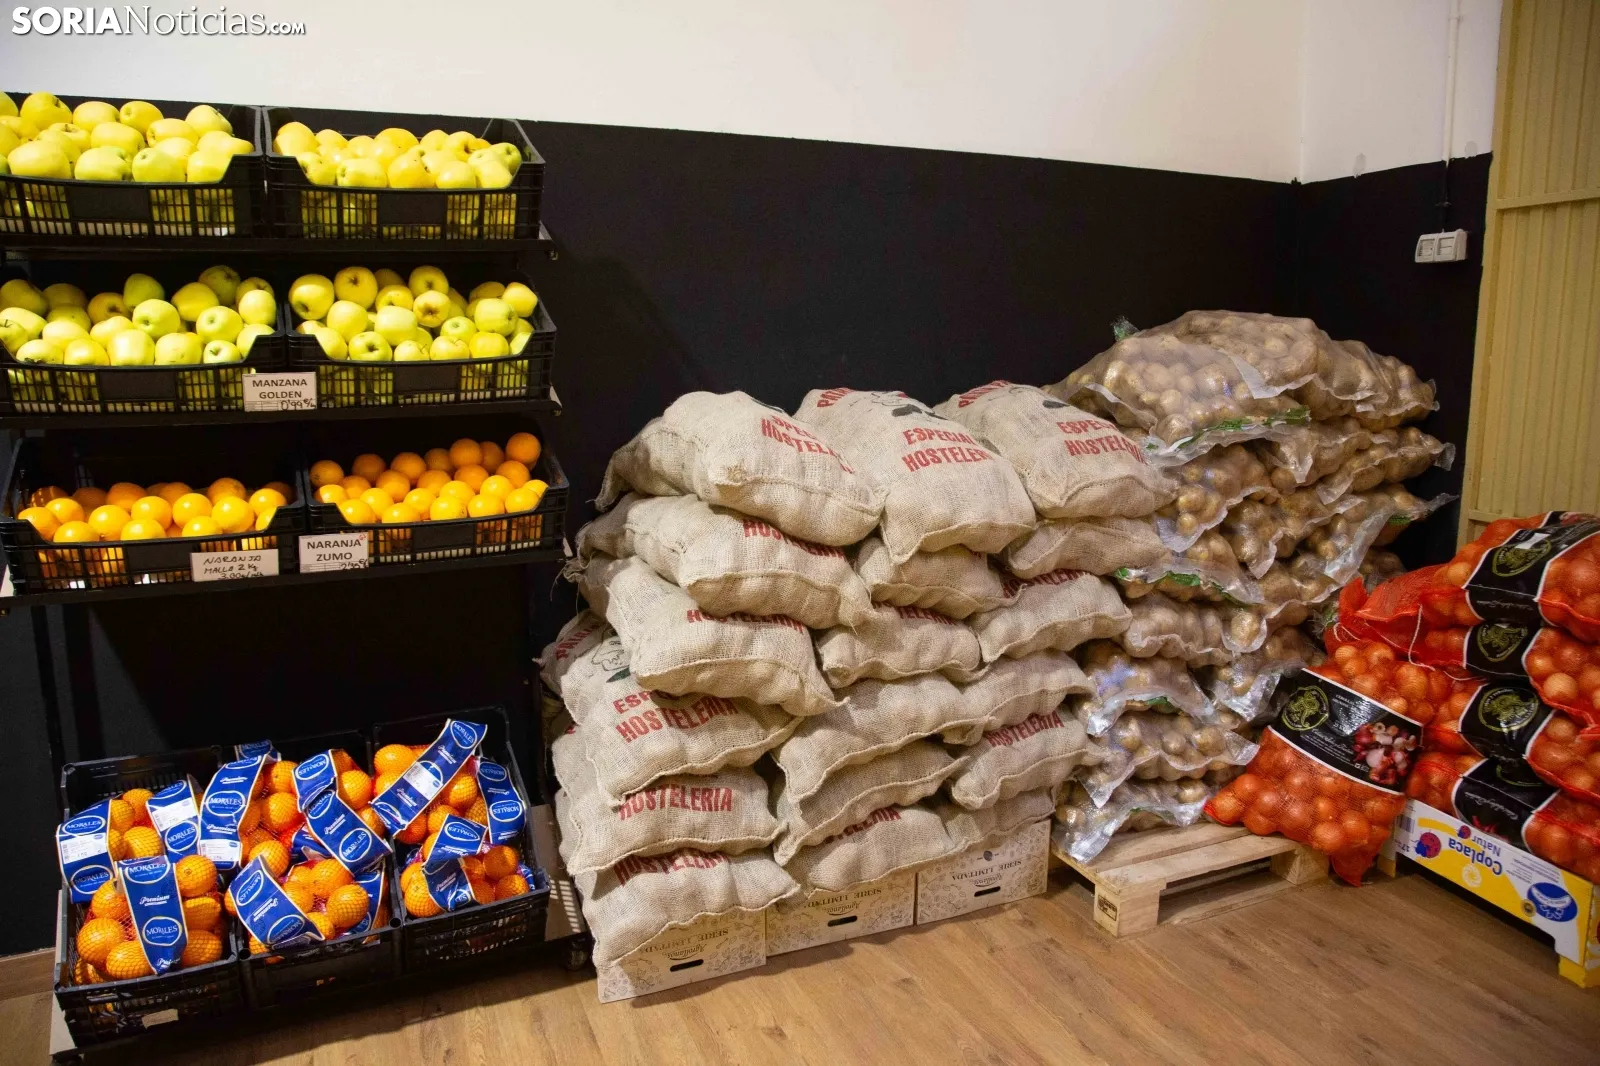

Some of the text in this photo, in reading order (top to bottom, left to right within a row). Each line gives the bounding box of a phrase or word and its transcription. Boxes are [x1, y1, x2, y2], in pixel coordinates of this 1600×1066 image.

[252, 379, 307, 387] MANZANA
[259, 391, 302, 399] GOLDEN
[307, 540, 361, 549] NARANJA
[316, 552, 352, 562] ZUMO
[616, 696, 739, 743] HOSTELERIA
[453, 722, 475, 744] MORALES
[208, 798, 242, 806] MORALES
[619, 783, 733, 821] HOSTELERIA
[492, 804, 521, 816] MORALES
[66, 820, 102, 830] MORALES
[167, 826, 196, 843] MORALES
[342, 831, 368, 857] MORALES
[1471, 835, 1501, 857] Natur
[1448, 837, 1504, 876] Coplaca
[129, 863, 167, 874] MORALES
[952, 860, 1022, 881] SERIE LIMITADA
[854, 887, 882, 899] SERIE
[146, 925, 178, 935] MORALES
[700, 928, 729, 940] SERIE
